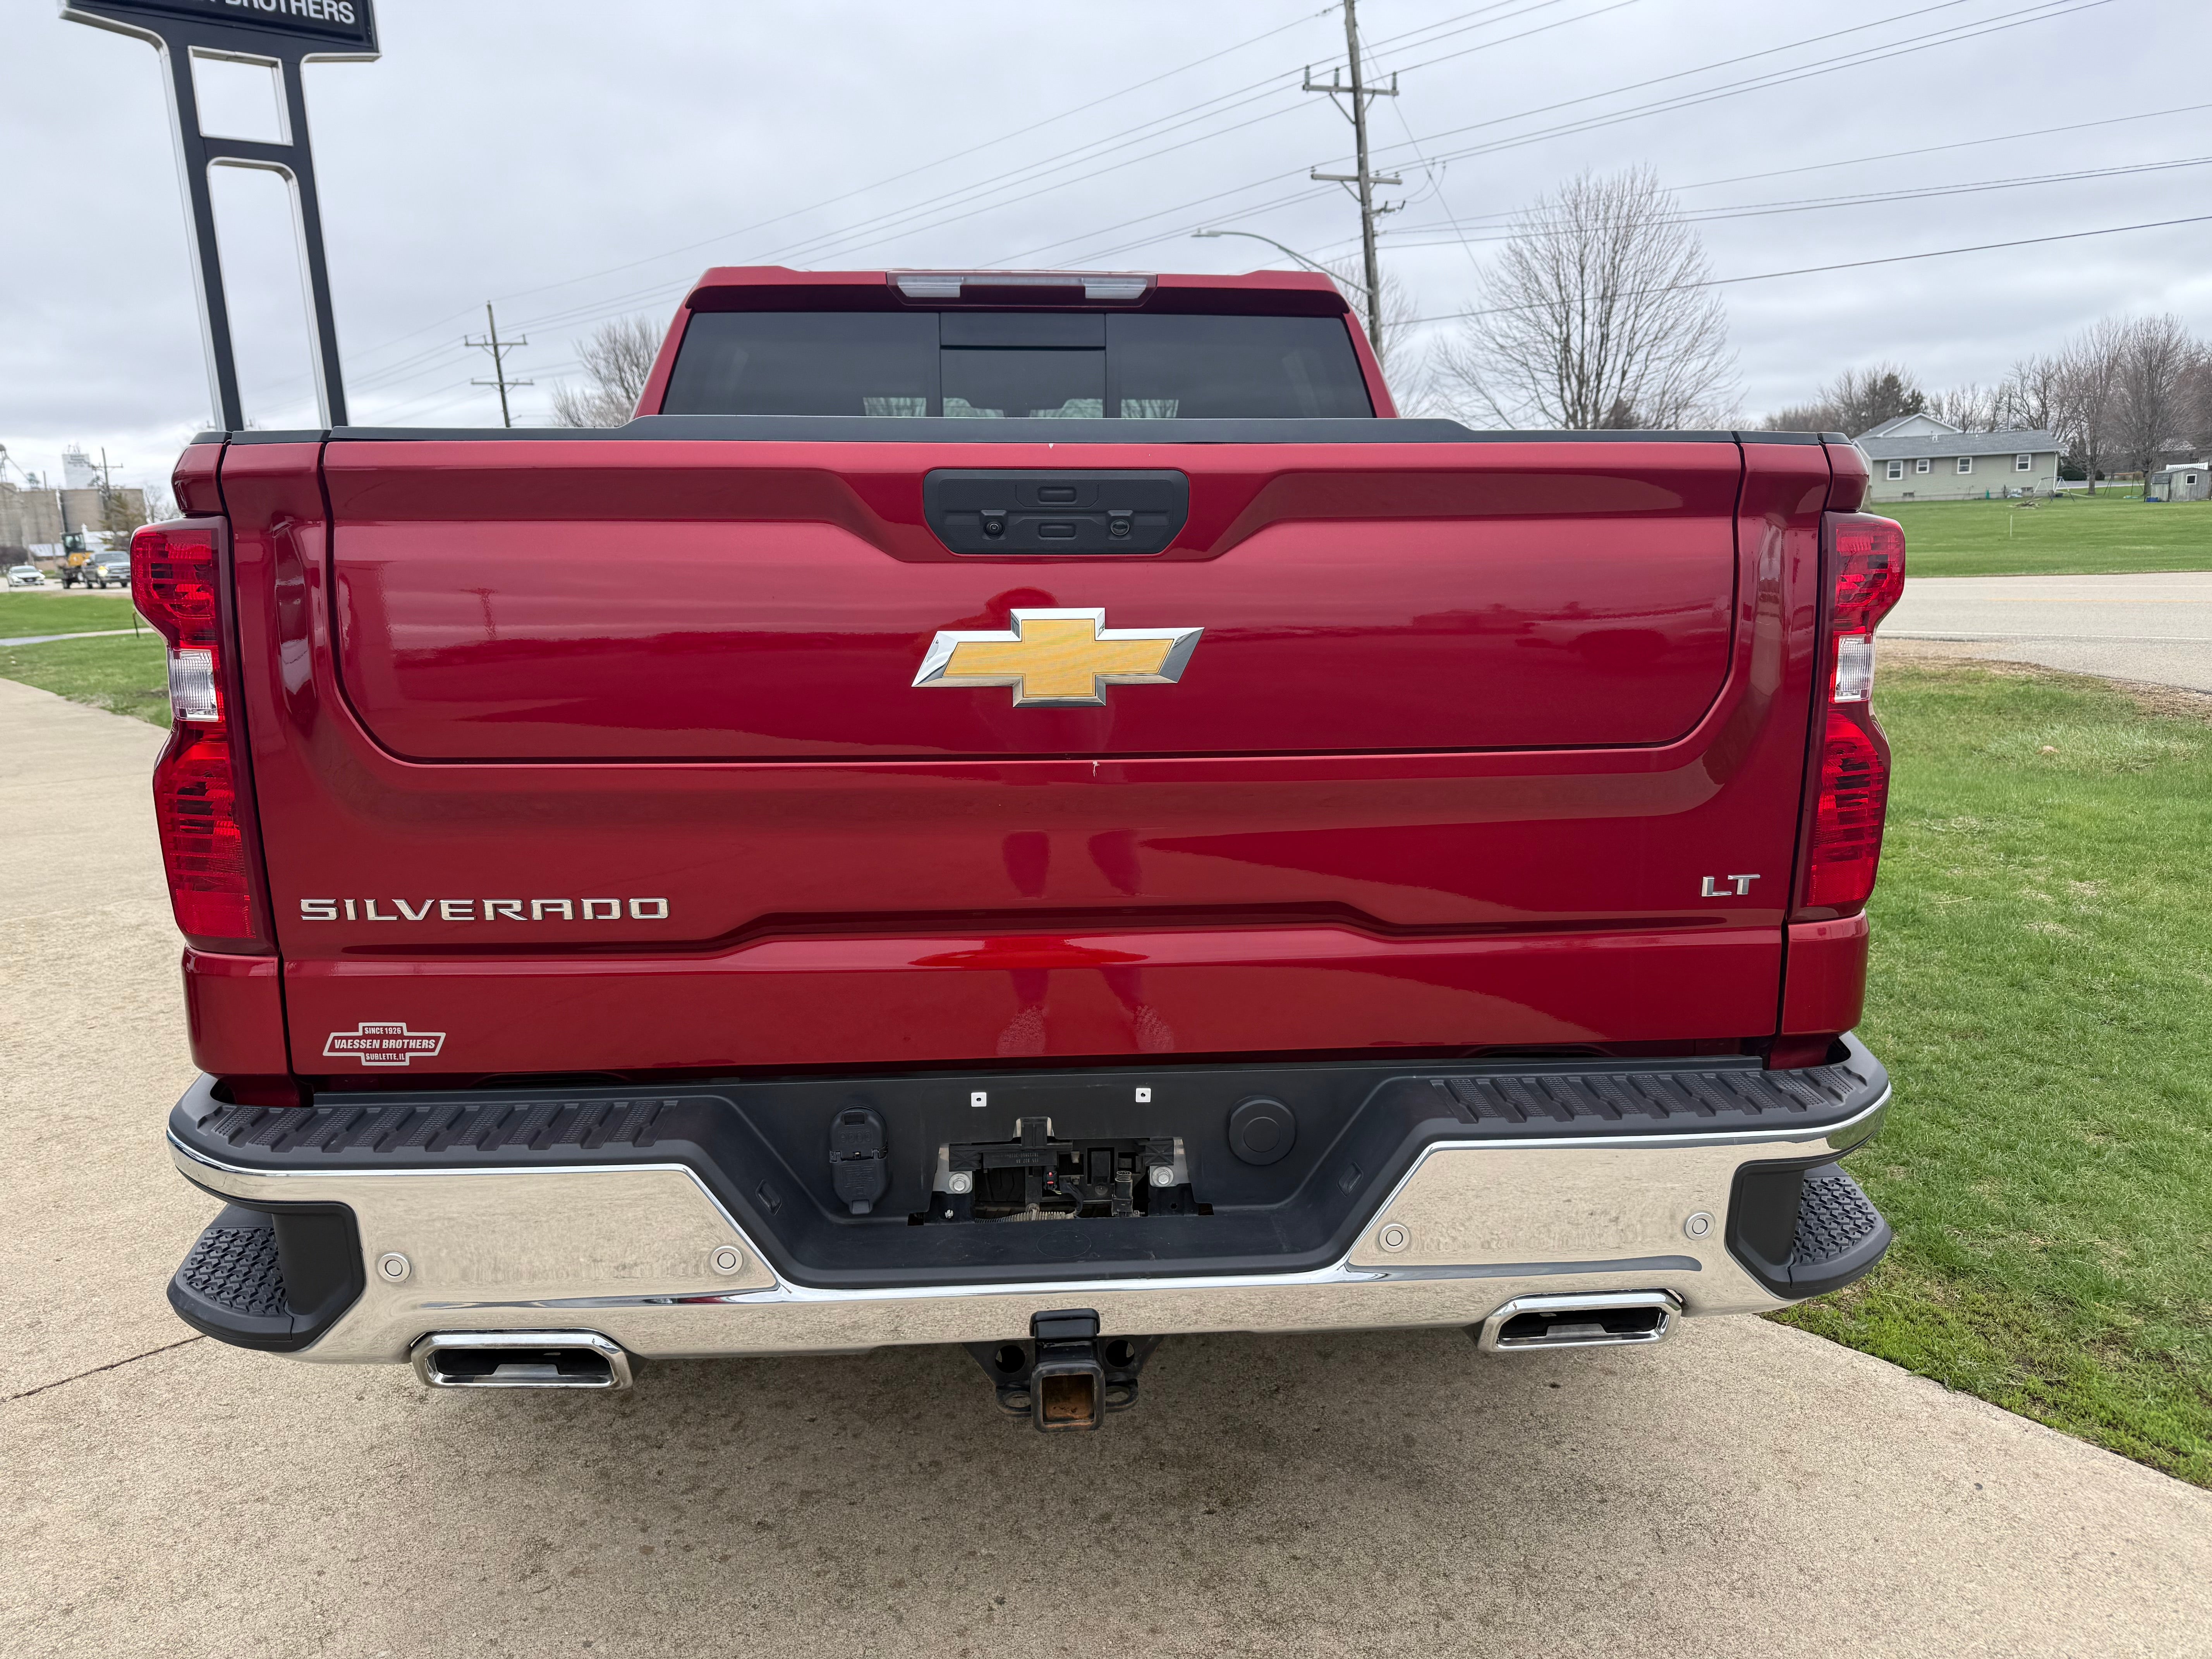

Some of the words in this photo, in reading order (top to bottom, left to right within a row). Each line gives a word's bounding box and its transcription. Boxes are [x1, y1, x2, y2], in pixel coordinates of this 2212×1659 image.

[1701, 874, 1760, 897] LT
[300, 898, 670, 921] SILVERADO
[335, 1039, 380, 1049] VAESSEN
[382, 1039, 435, 1049] BROTHERS
